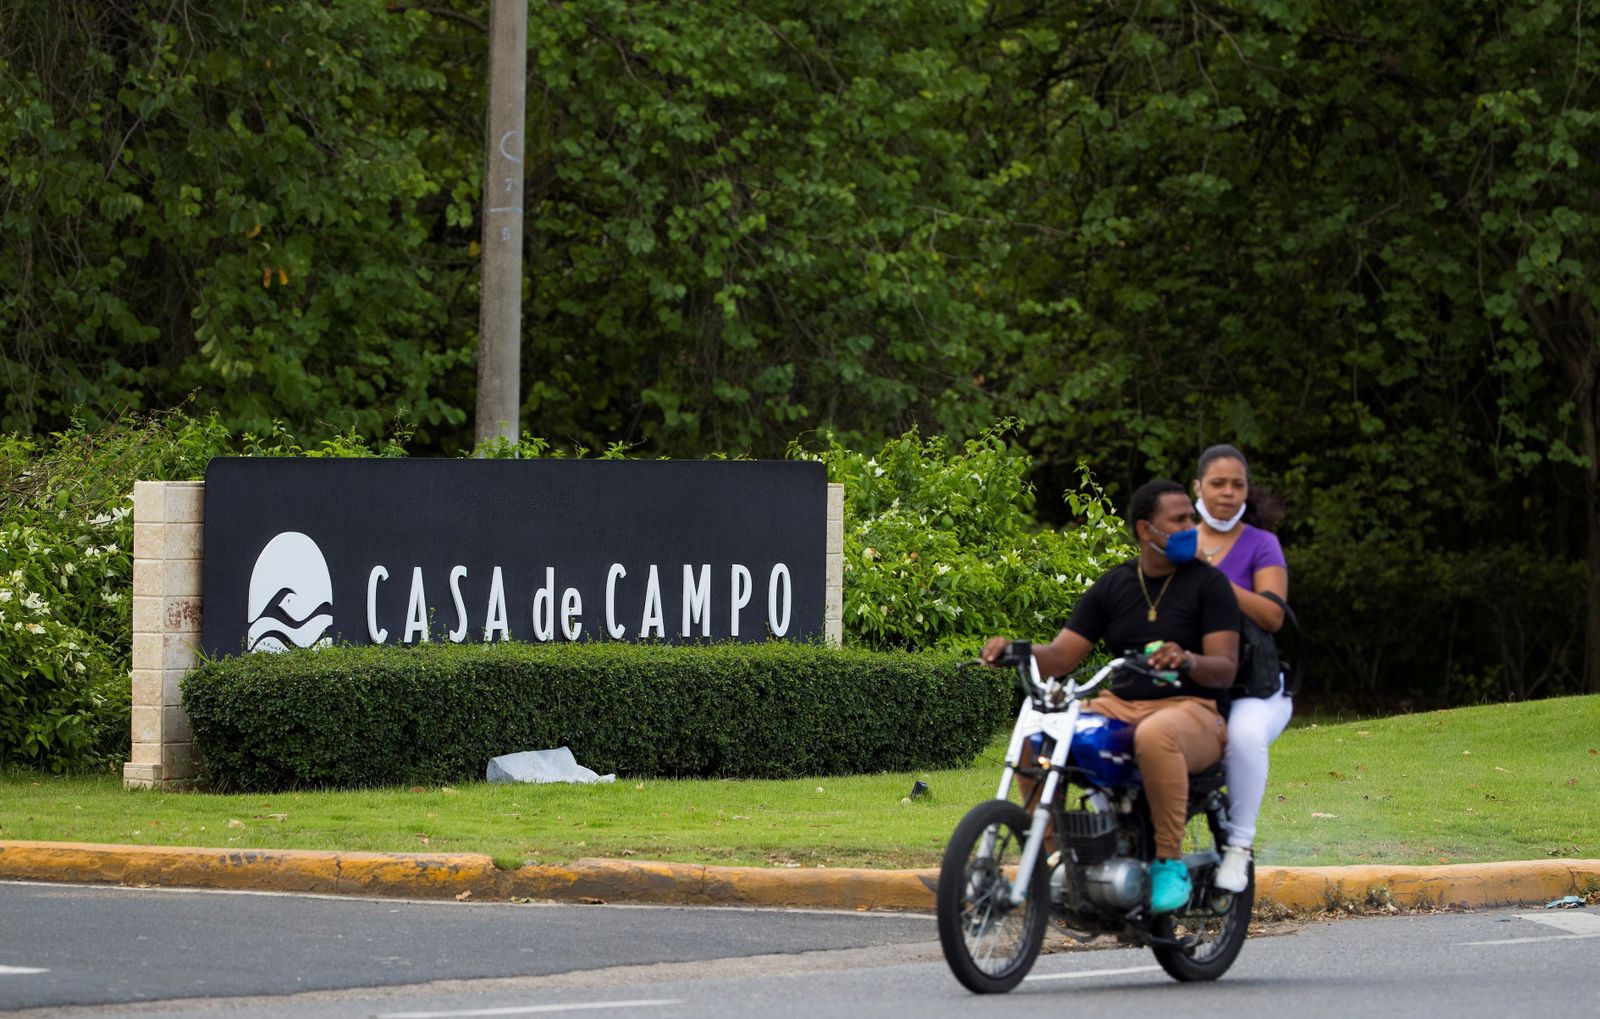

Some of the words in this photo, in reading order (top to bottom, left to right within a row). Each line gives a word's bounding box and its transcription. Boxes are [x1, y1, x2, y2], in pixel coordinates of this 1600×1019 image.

[366, 564, 511, 645] CASA
[532, 566, 583, 643] de
[605, 562, 793, 640] CAMPO
